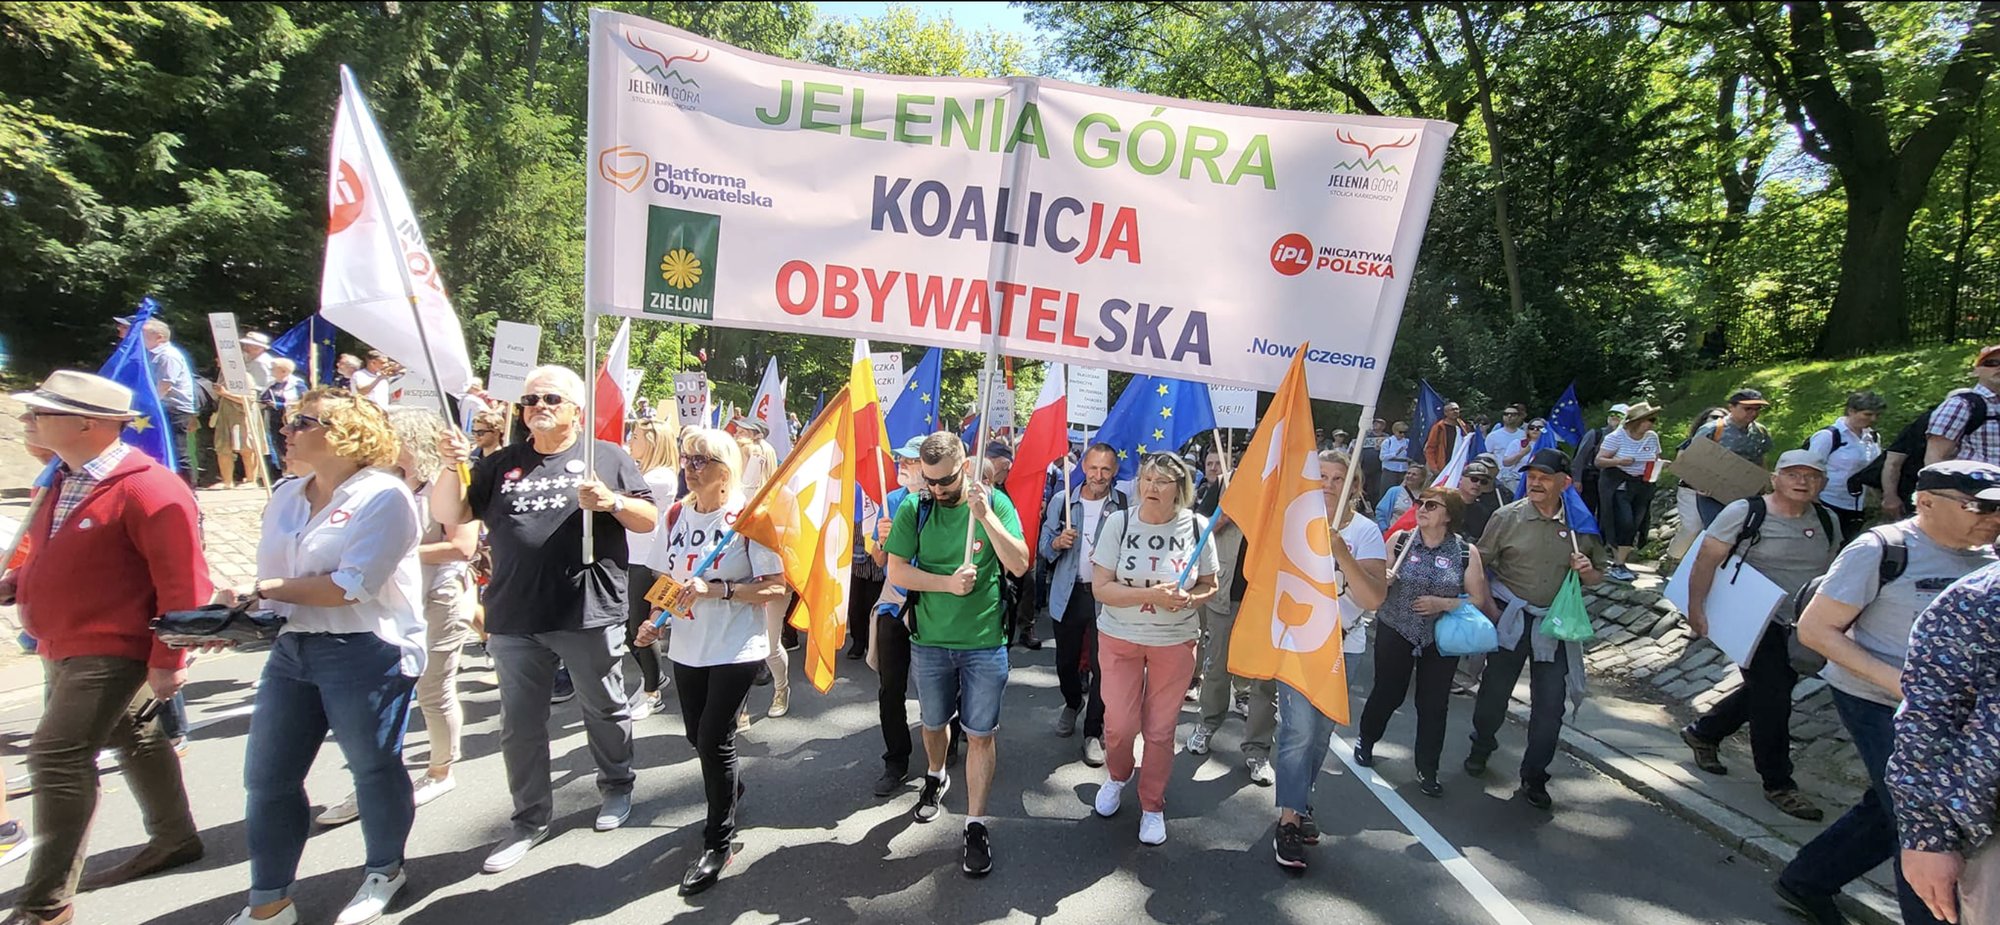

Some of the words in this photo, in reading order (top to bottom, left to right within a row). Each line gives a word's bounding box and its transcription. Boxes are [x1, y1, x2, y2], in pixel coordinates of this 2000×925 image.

[628, 79, 669, 97] JELENIA
[632, 96, 656, 105] STOLICA
[755, 79, 1050, 160] JELENIA
[1073, 106, 1278, 190] GÓRA
[654, 162, 746, 189] Platforma
[1328, 174, 1369, 190] JELENIA
[653, 178, 773, 208] Obywatelska
[1354, 192, 1393, 202] KARKONOSZY
[871, 175, 1141, 264] KOALICJA
[1319, 246, 1393, 263] INICJATYWA
[1316, 257, 1395, 279] POLSKA
[650, 292, 708, 314] ZIELONI
[775, 260, 1212, 367] OBYWATELSKA
